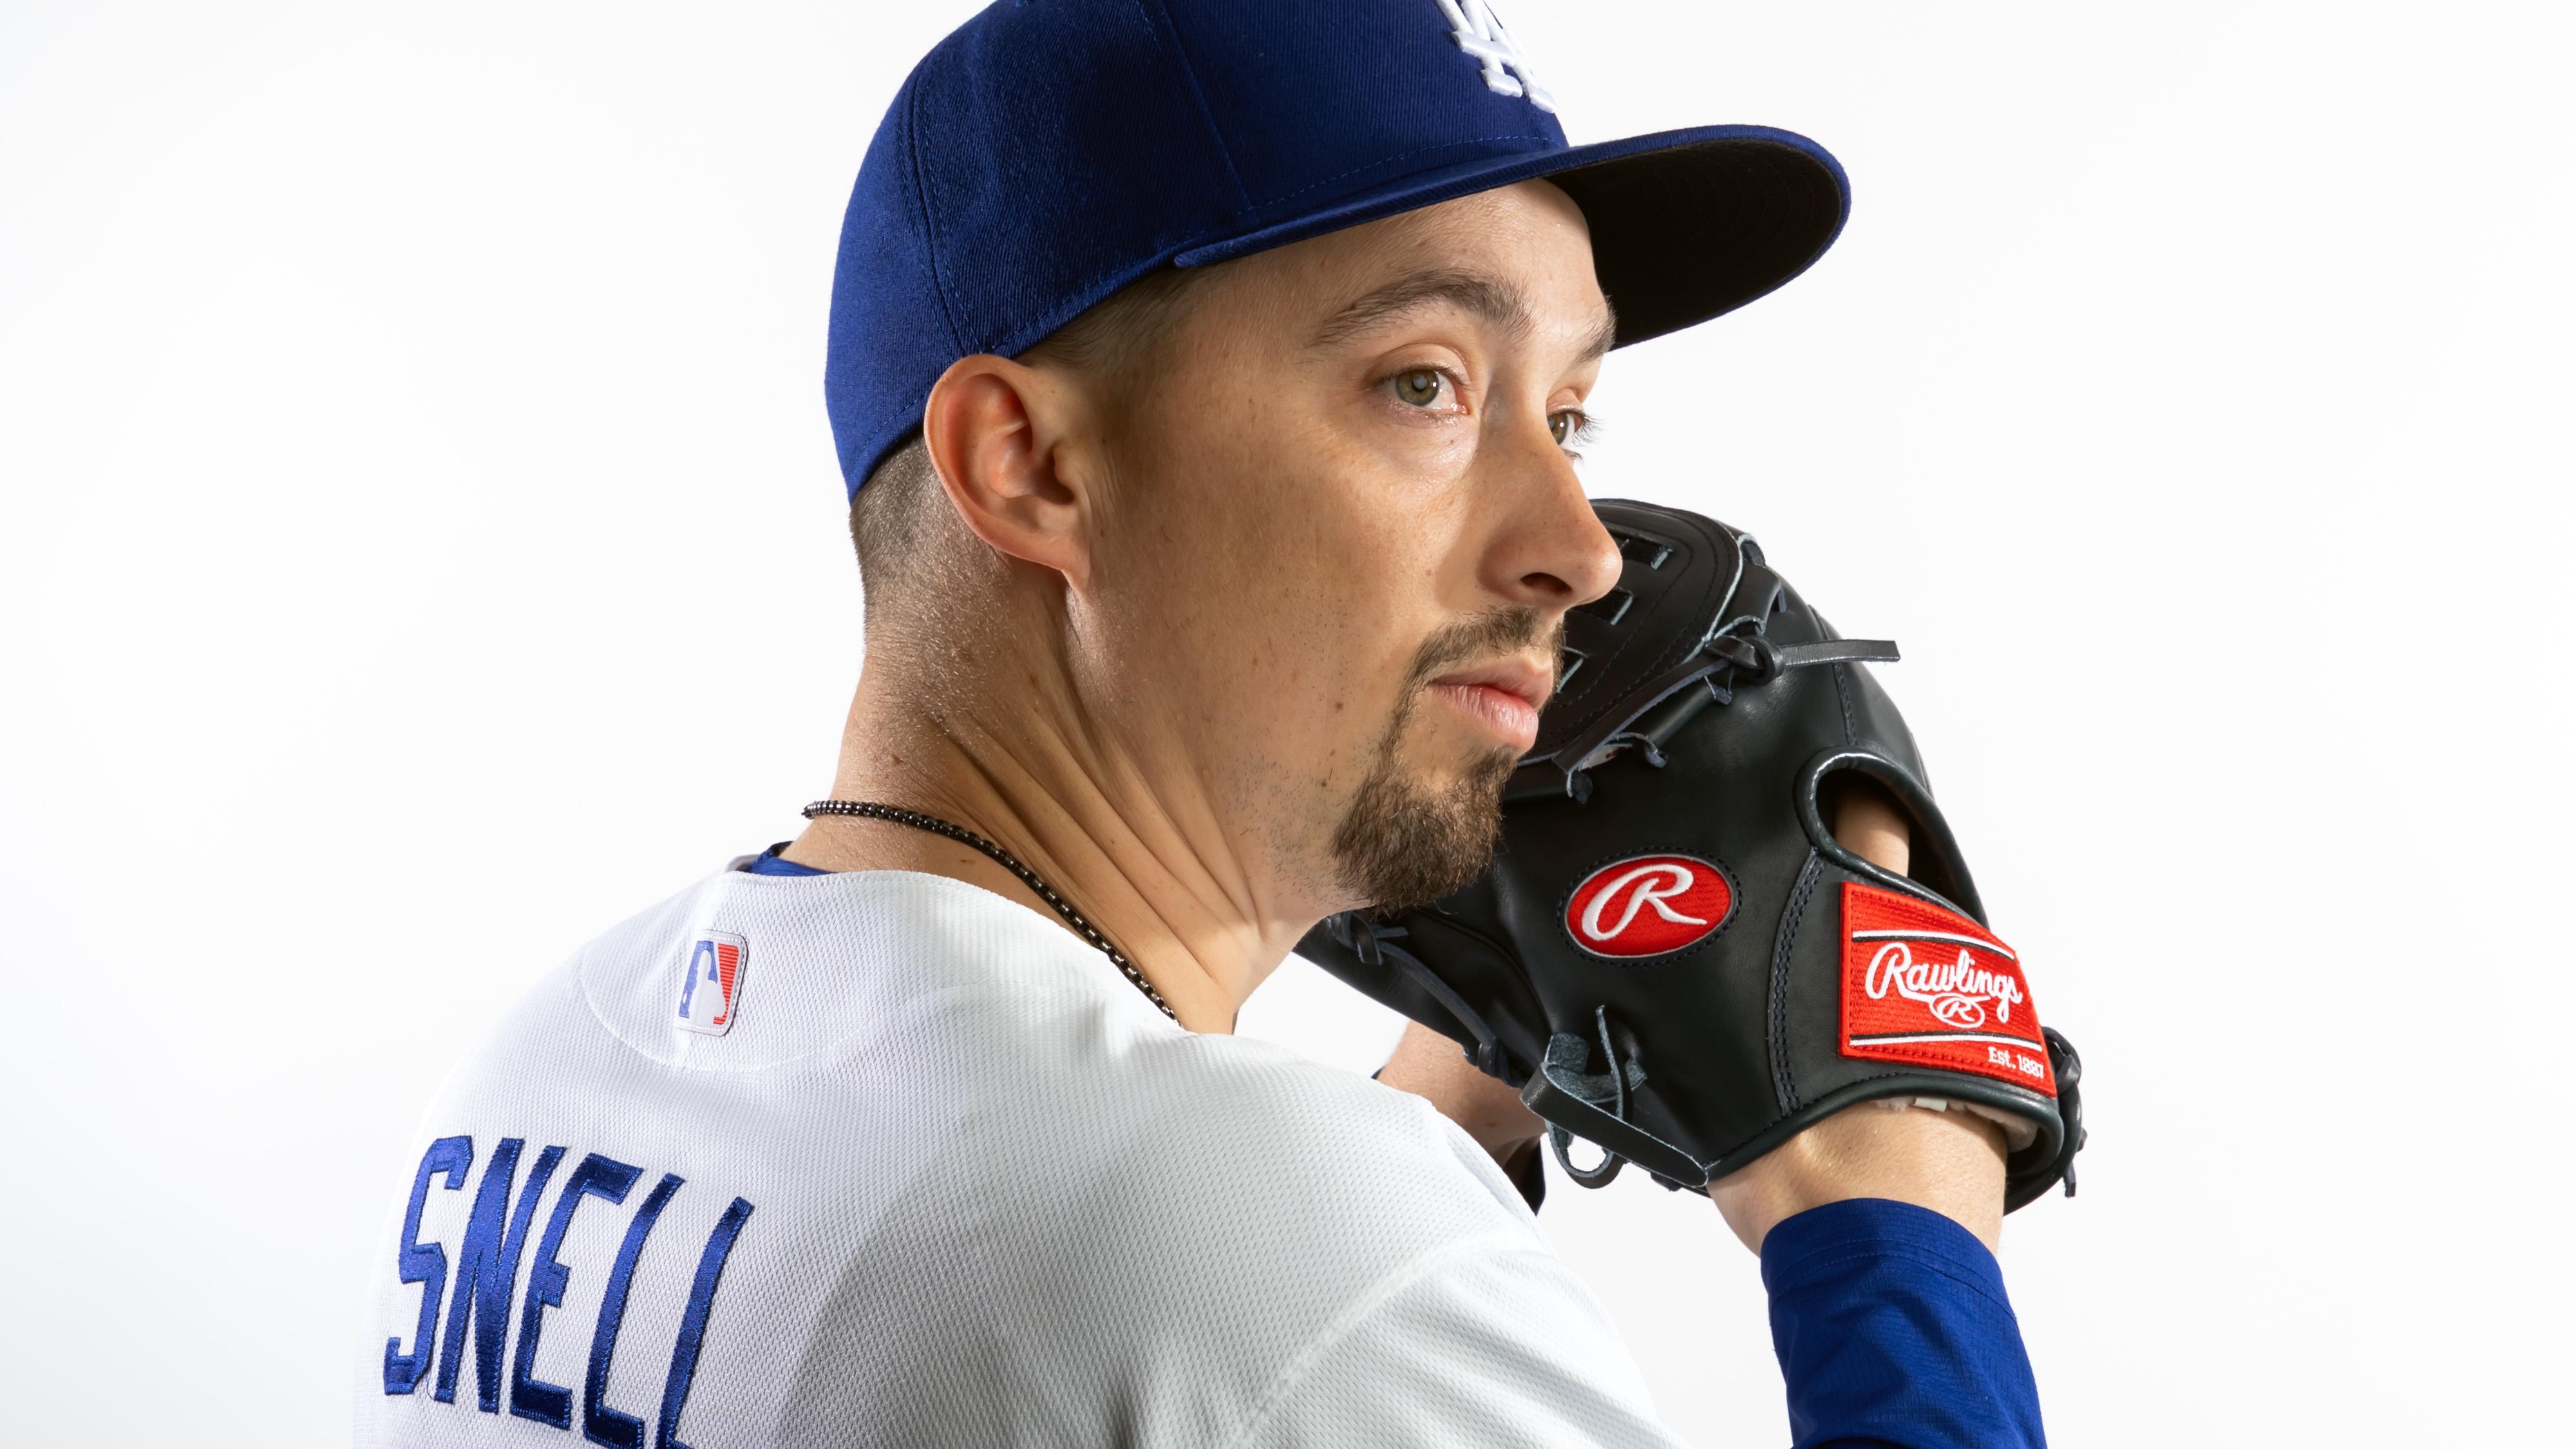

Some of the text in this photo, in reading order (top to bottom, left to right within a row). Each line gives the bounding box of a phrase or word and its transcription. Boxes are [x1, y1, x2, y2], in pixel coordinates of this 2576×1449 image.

[1582, 864, 1708, 942] R
[1865, 942, 2023, 1023] Rawlings
[1988, 1046, 2045, 1080] Est. 1887
[384, 1135, 755, 1449] SNELL
